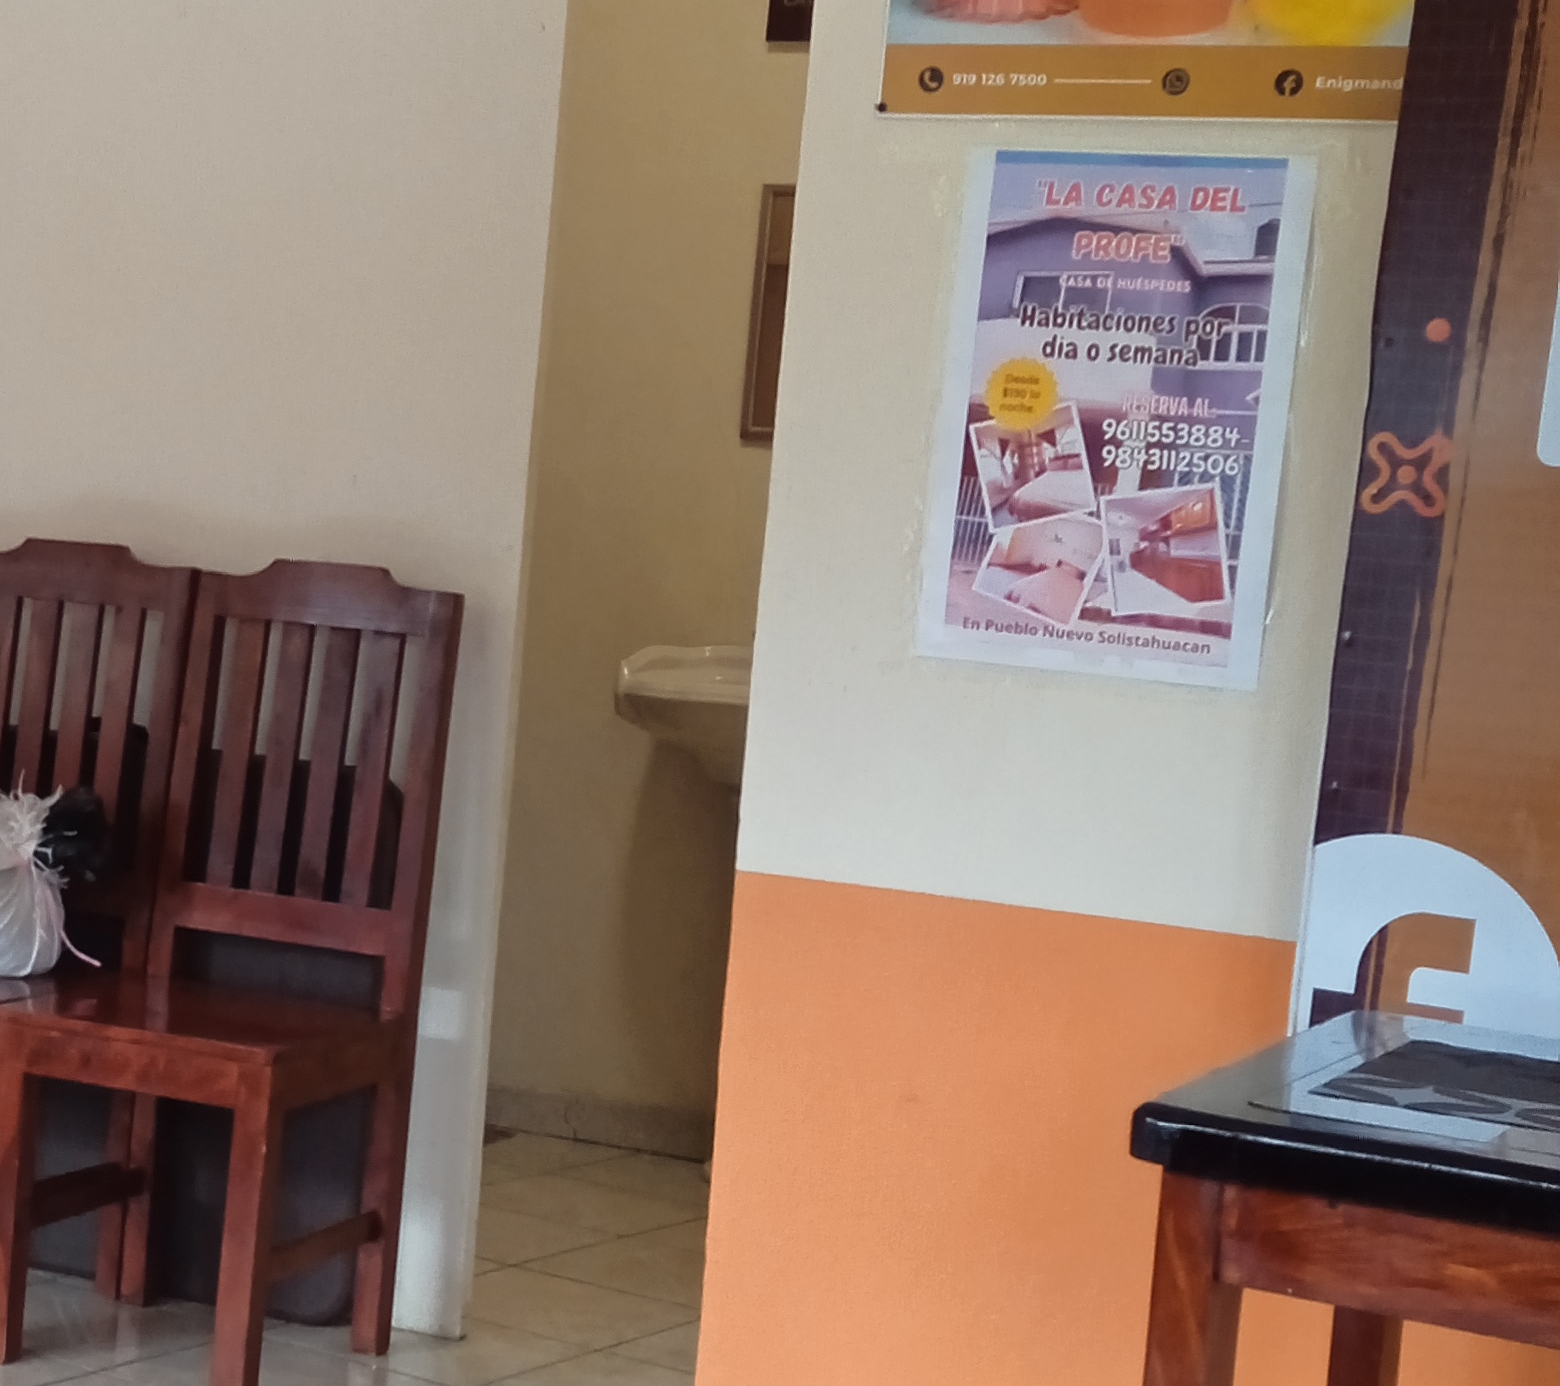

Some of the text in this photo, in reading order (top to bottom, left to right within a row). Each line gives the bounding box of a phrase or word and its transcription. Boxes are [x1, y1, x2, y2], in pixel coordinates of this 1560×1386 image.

[1094, 181, 1179, 213] CASA
[1189, 184, 1248, 215] DEL
[1059, 275, 1092, 289] CASA
[1096, 276, 1114, 290] DE
[1019, 303, 1232, 344] Habitaciones por
[1086, 343, 1101, 363] o
[1106, 341, 1200, 369] semana
[1121, 394, 1188, 416] RESERVA
[1101, 444, 1241, 476] 9843112506
[962, 615, 981, 631] En
[985, 618, 1040, 637] Pueblo
[1042, 626, 1095, 643] Nuevo
